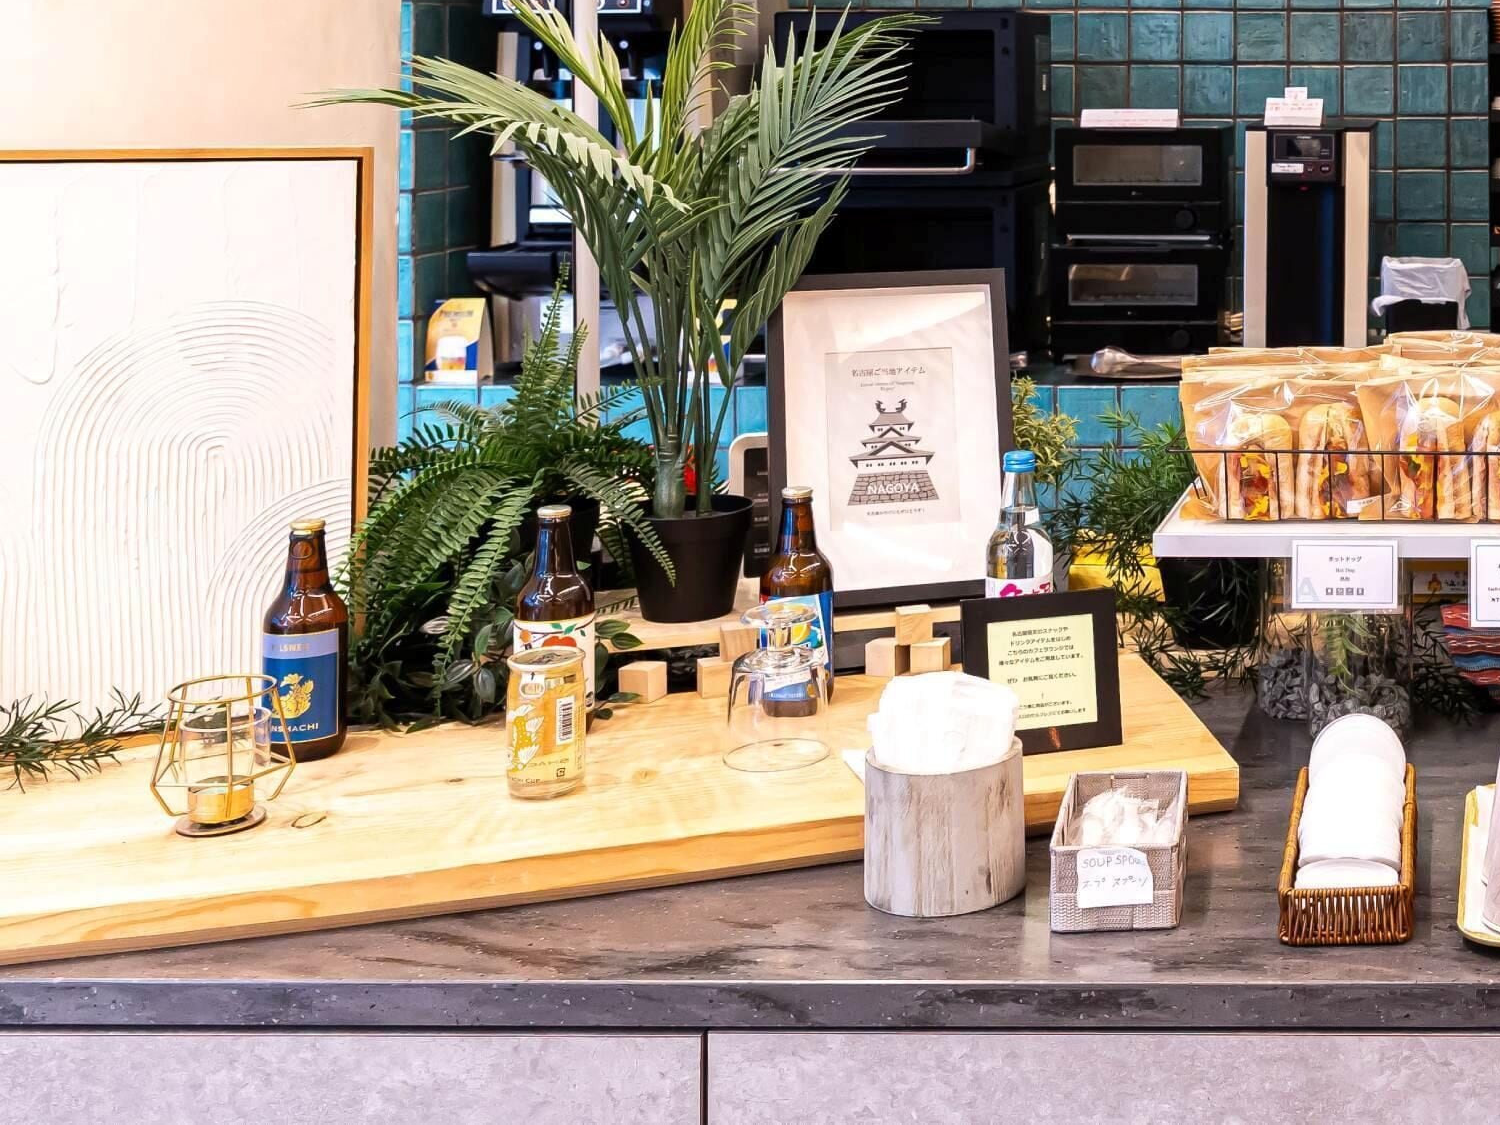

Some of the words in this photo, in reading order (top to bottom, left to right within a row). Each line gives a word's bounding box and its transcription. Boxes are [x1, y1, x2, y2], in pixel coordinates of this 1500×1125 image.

[867, 482, 920, 495] NAGOYA
[1010, 635, 1072, 647] ドリンクアイテムをはじめ
[1007, 644, 1075, 656] こちらのカフェラウンジでは
[1082, 856, 1113, 869] SOUP
